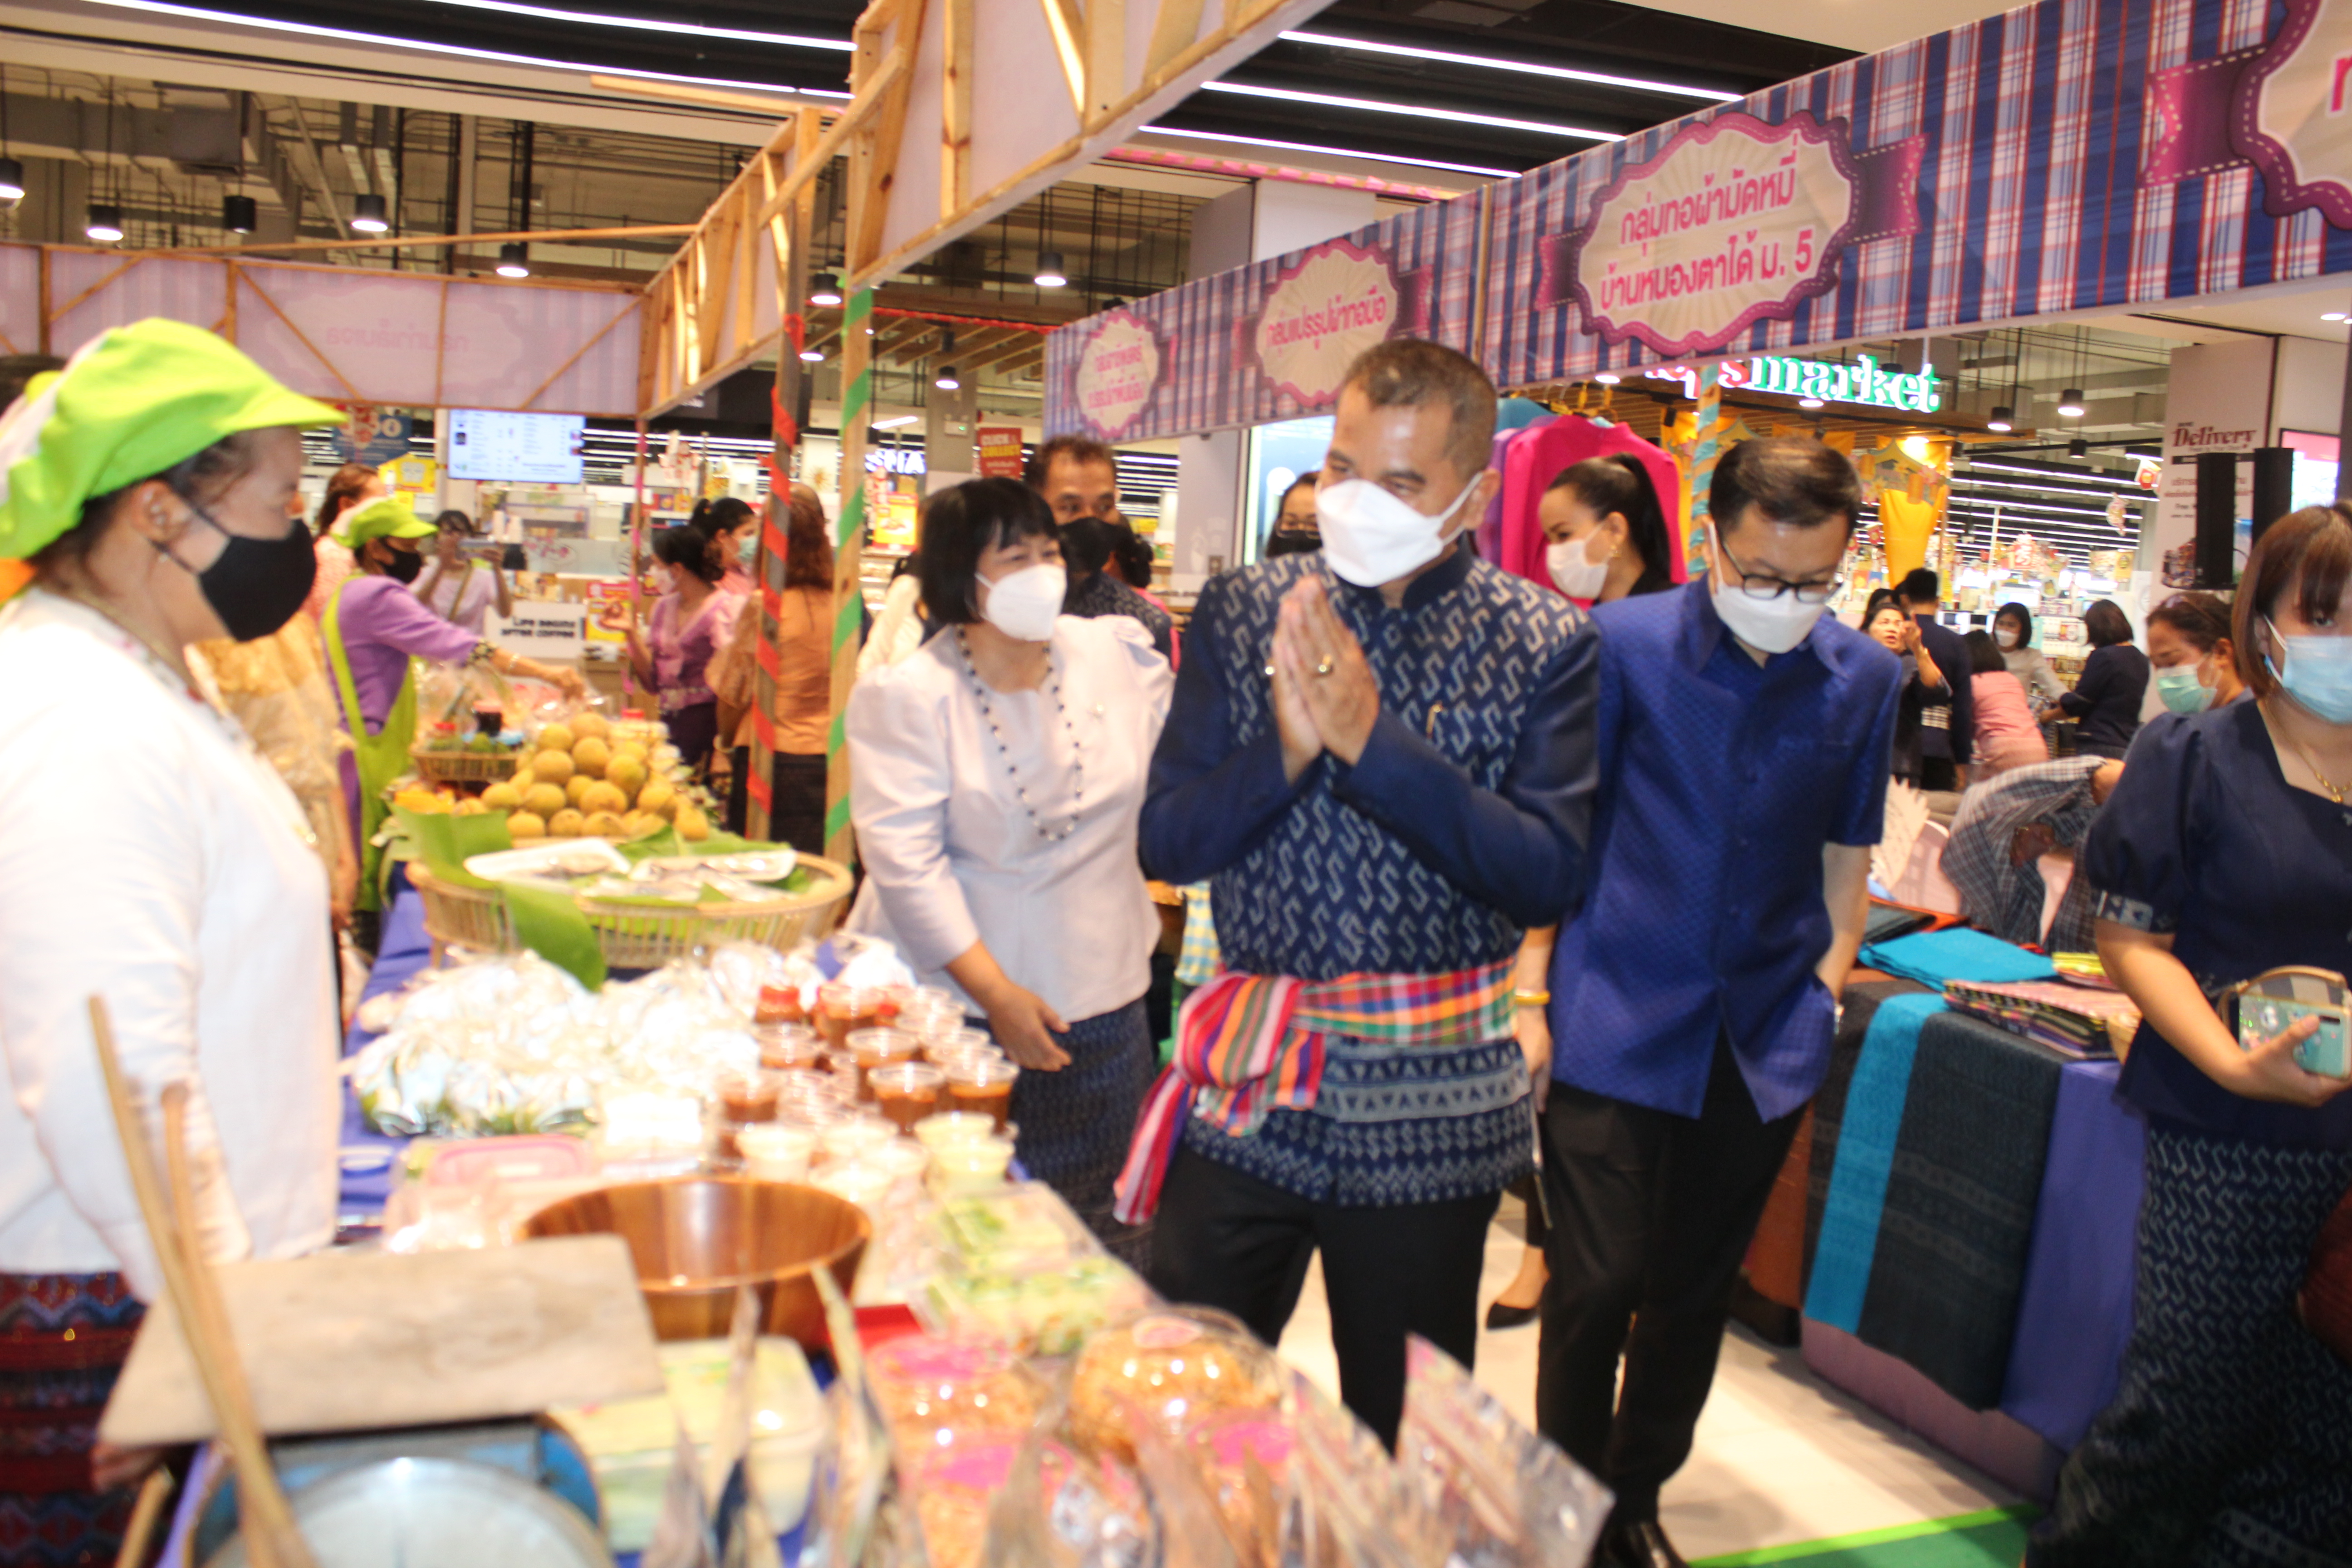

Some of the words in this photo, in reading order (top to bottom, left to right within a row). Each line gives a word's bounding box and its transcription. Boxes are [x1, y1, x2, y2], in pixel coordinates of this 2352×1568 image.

[1621, 133, 1798, 257] กลุ่มทอผ้ามัดหมี่
[1794, 229, 1813, 273] 5
[1743, 355, 1941, 412] market
[2171, 426, 2256, 448] Delivery
